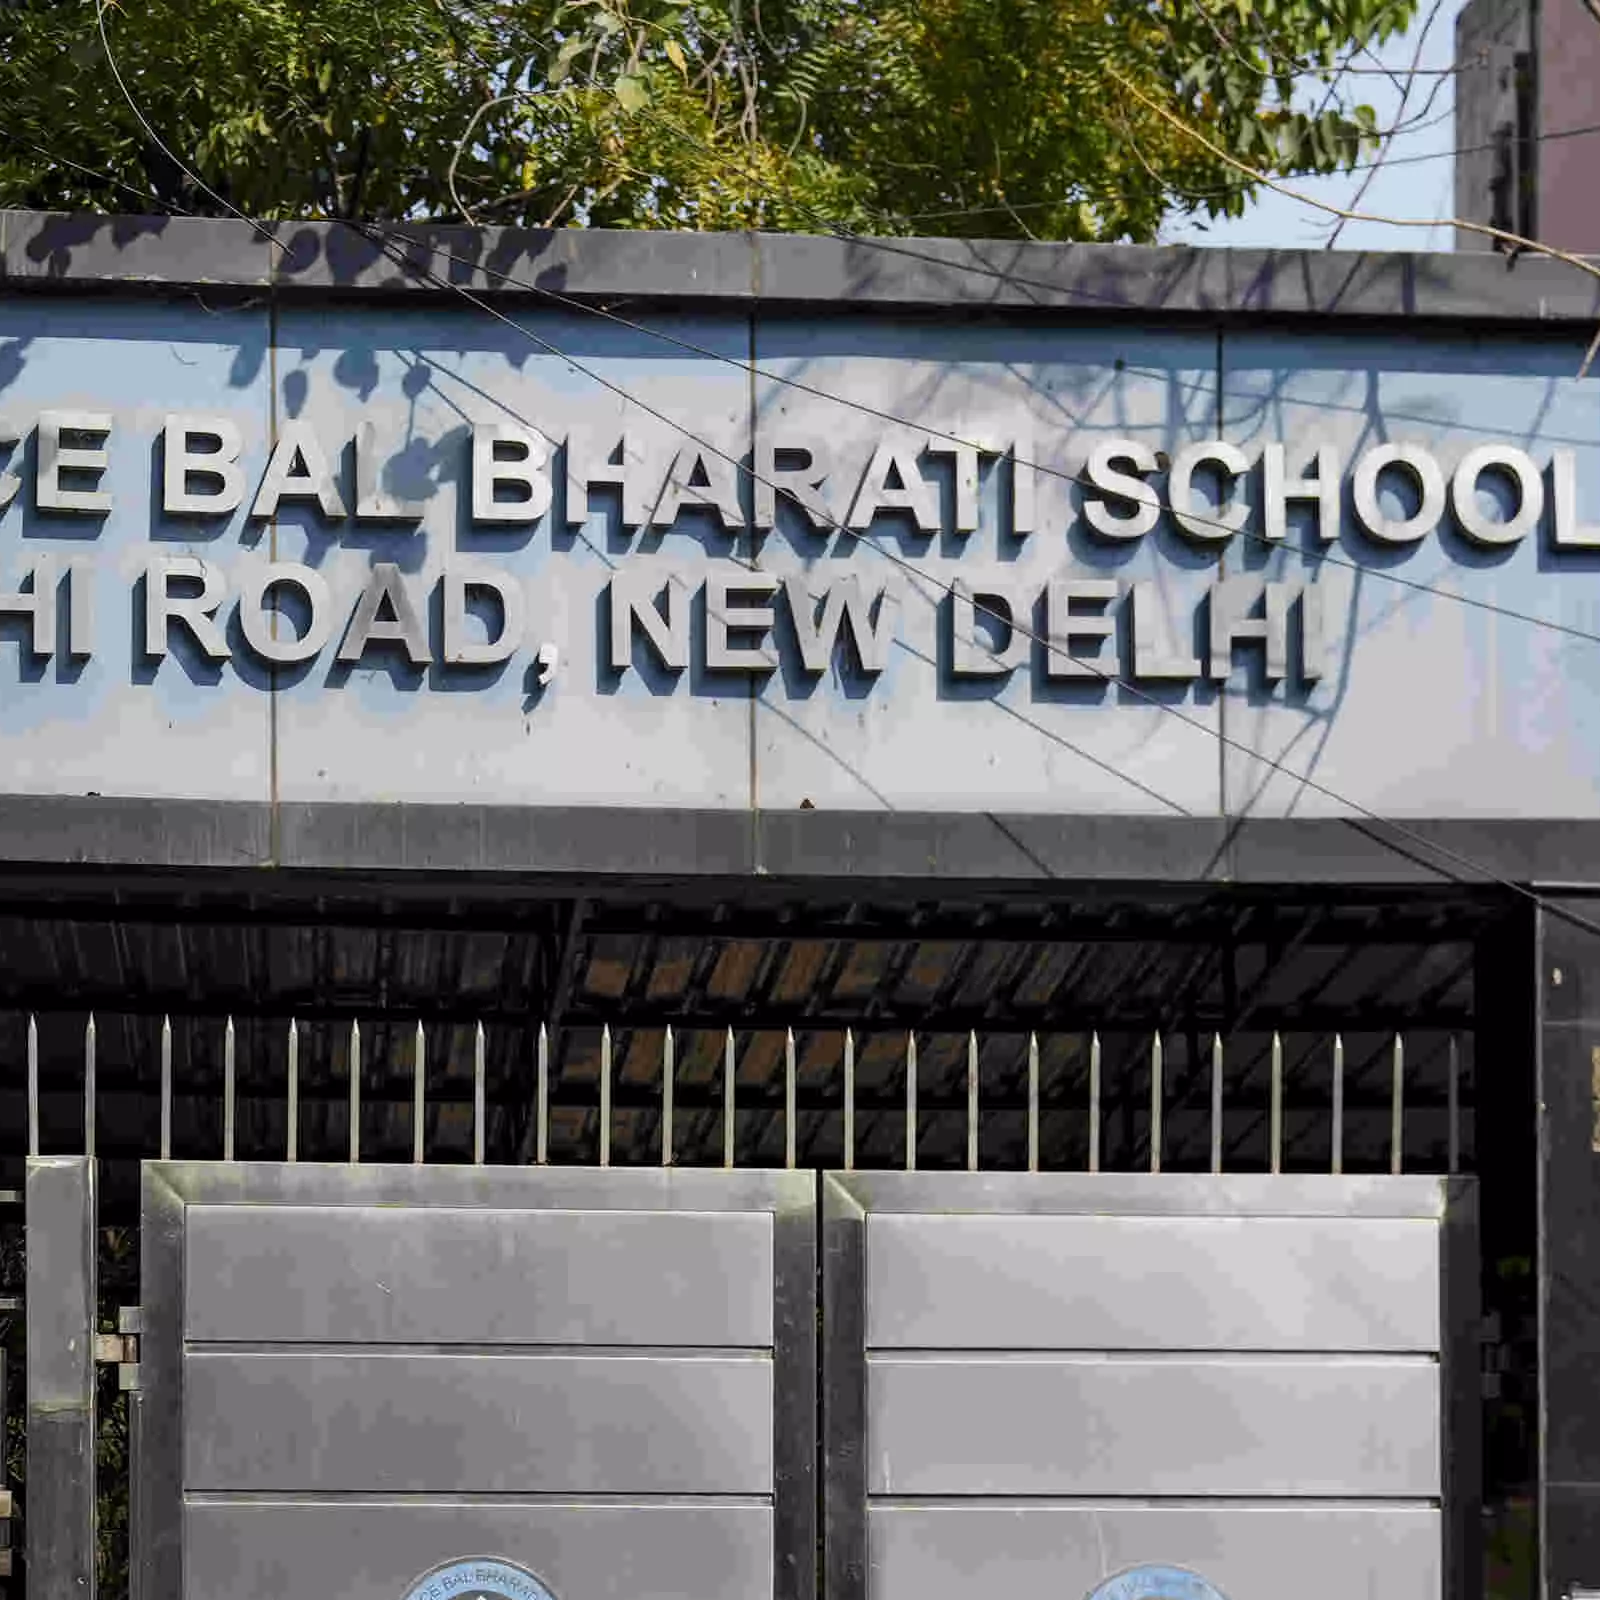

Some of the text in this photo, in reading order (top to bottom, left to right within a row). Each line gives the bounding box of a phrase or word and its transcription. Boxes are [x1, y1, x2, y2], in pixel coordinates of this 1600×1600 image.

[162, 413, 424, 520] BAL
[473, 420, 1035, 534] BHARATI
[144, 556, 558, 686] ROAD,
[608, 568, 896, 674] NEW
[952, 577, 1326, 684] DELHI
